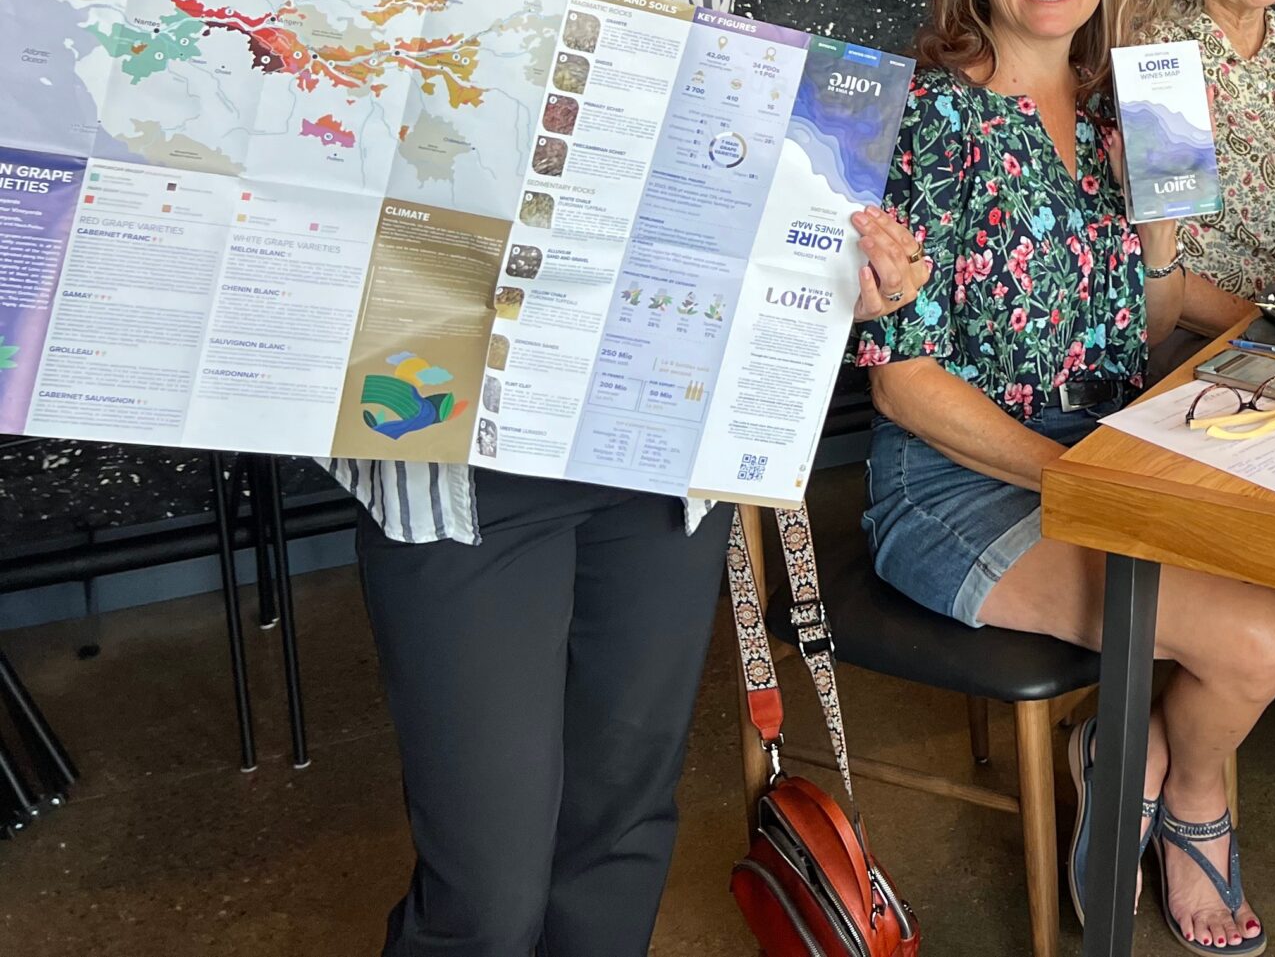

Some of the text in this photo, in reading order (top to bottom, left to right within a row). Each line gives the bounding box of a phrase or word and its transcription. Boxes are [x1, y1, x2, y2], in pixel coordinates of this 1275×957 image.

[570, 0, 633, 18] MAGMATIC ROCKS
[648, 1, 678, 14] SOILS
[134, 17, 161, 27] Nantes
[697, 12, 757, 33] KEY FIGURES
[1138, 58, 1180, 72] LOIRE
[829, 72, 882, 97] Loire
[16, 165, 74, 183] GRAPE
[572, 185, 596, 195] ROCKS
[1154, 177, 1196, 195] Loire
[385, 206, 431, 221] CLIMATE
[79, 216, 184, 235] RED GRAPE VARIETIES
[791, 220, 844, 236] WINES MAP
[77, 228, 151, 242] CABERNET FRANC
[786, 229, 843, 253] LOIRE
[232, 234, 341, 254] WHITE GRAPE VARIETIES
[230, 245, 287, 258] MELON BLANC
[62, 290, 93, 299] GAMAY
[221, 284, 281, 296] CHENIN BLANC
[765, 287, 831, 313] Loire
[49, 346, 93, 356] GROLLEAU
[210, 338, 286, 351] SAUVIGNON BLANC
[601, 348, 632, 360] 250 Mio
[202, 368, 259, 379] CHARDONNAY
[38, 390, 135, 405] CABERNET SAUVIGNON
